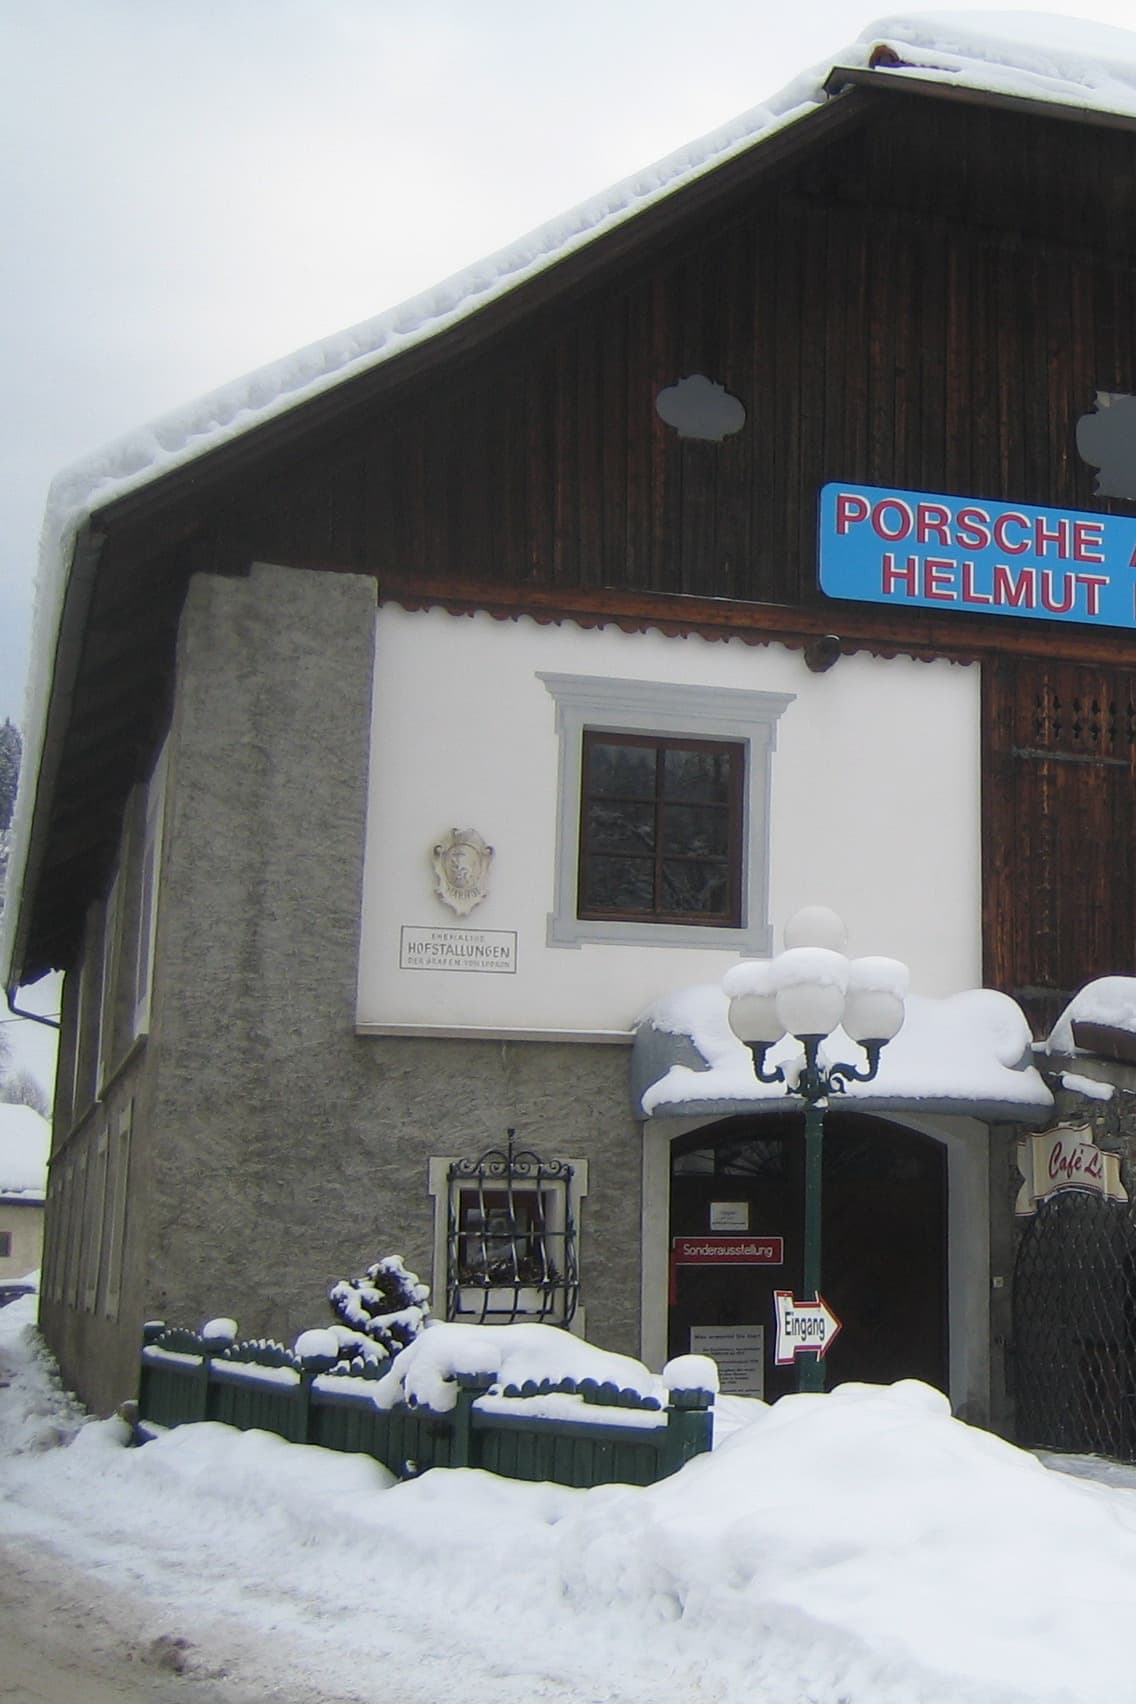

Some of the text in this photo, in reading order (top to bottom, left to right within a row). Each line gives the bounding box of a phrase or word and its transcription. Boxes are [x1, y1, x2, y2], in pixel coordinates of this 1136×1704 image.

[834, 492, 1105, 563] PORSCHE
[880, 552, 1110, 615] HELMUT
[407, 942, 511, 959] HOFSTALLUNGEN
[1049, 1141, 1084, 1179] Café
[683, 1243, 773, 1257] Sonderausstellung
[784, 1311, 825, 1341] Eingang
